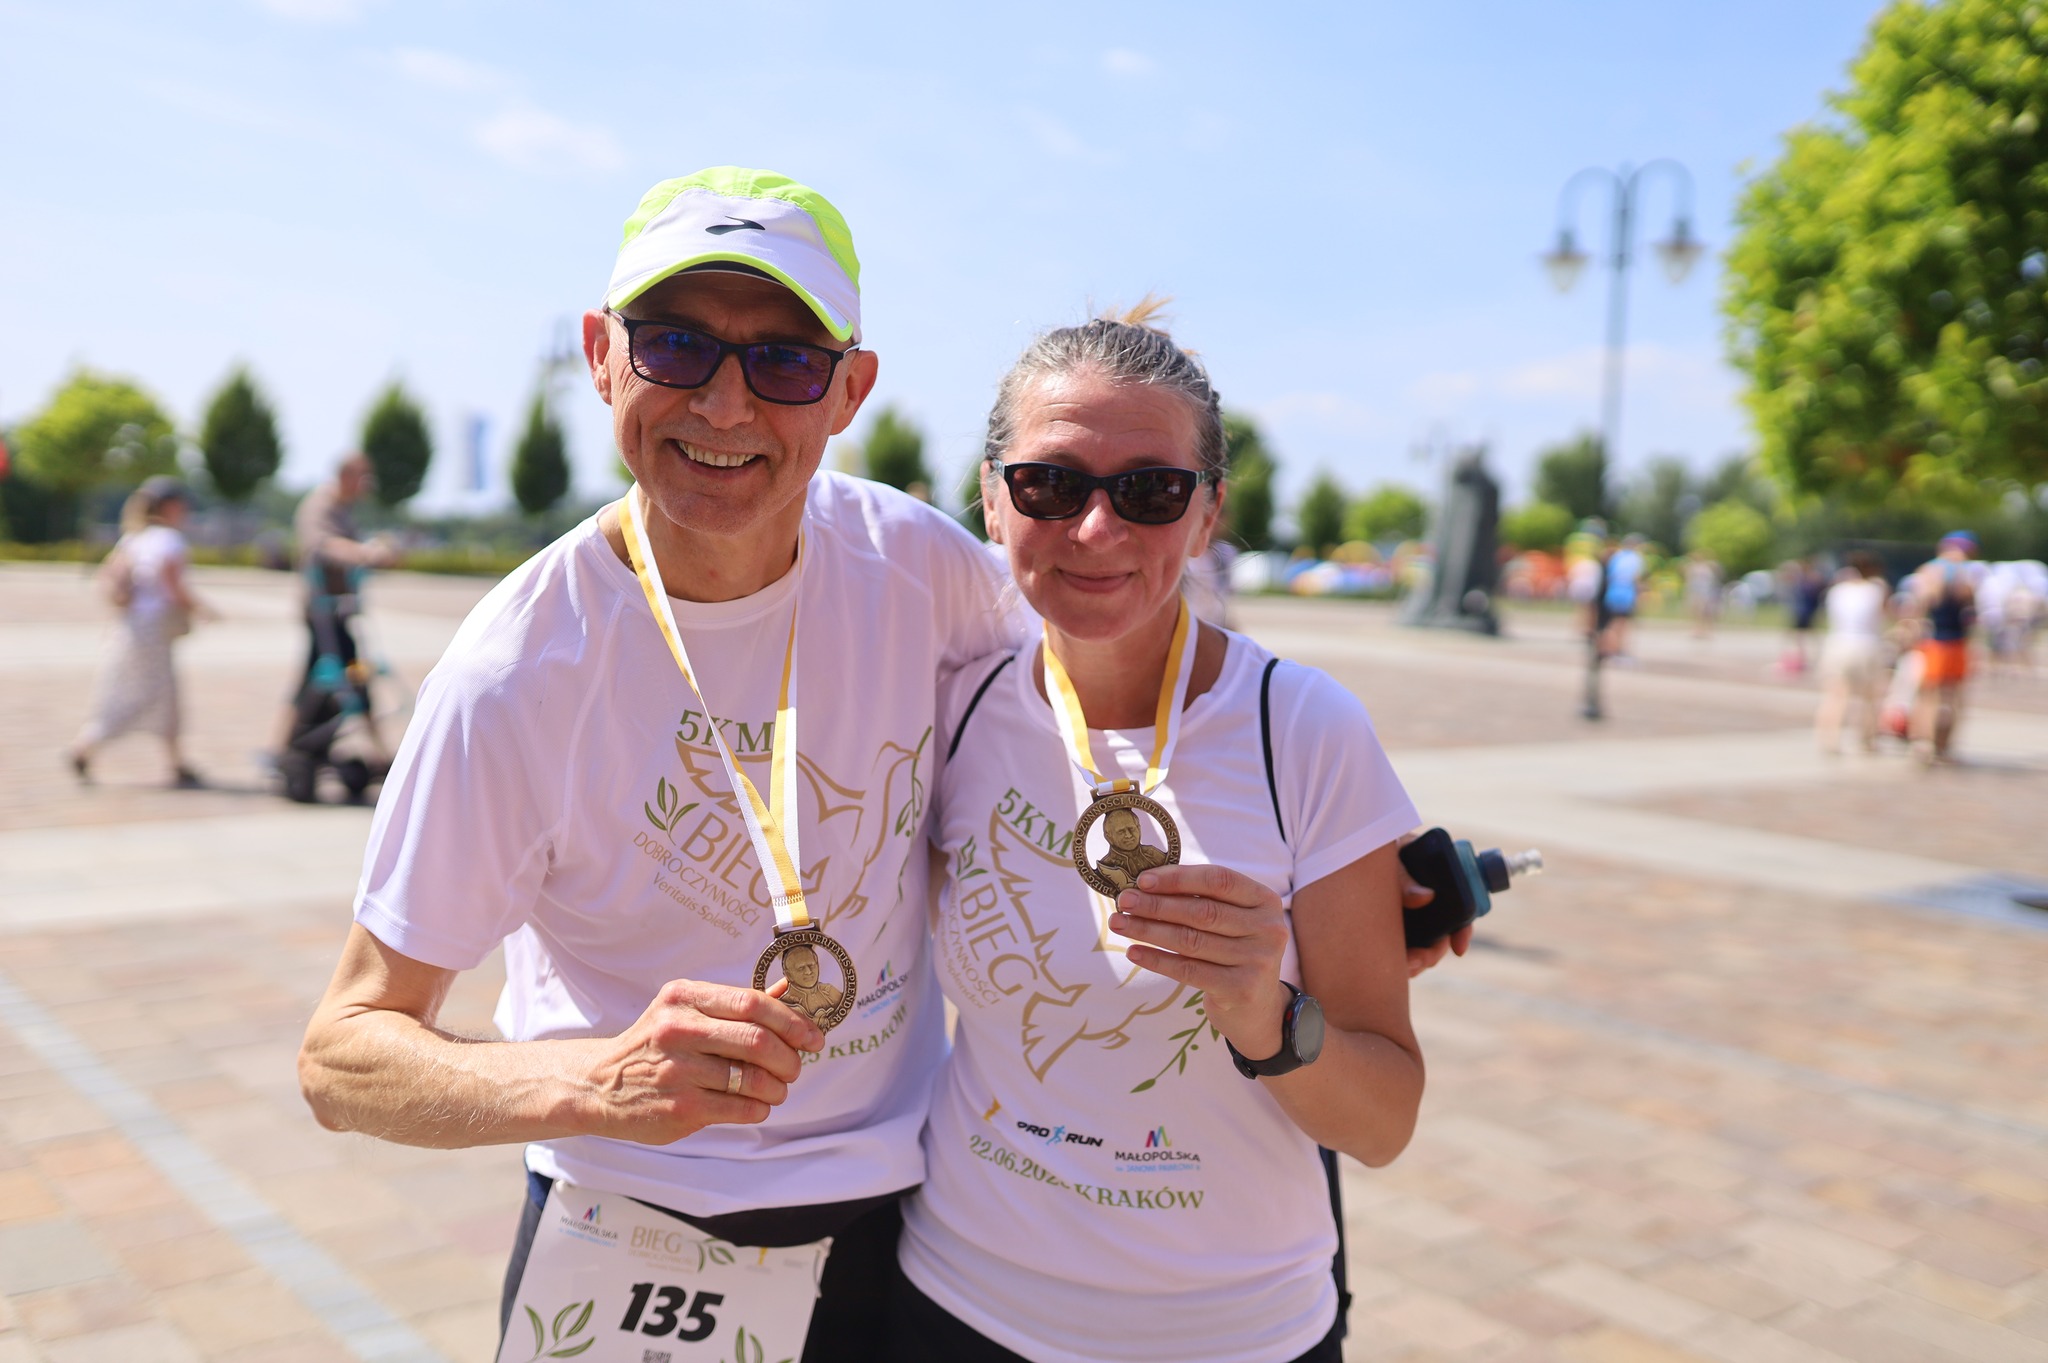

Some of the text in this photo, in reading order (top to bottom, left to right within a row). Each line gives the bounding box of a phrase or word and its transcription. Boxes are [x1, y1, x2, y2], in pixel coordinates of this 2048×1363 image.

[676, 709, 775, 753] 5KM
[997, 787, 1074, 858] 5KM
[1086, 876, 1110, 894] BIEG
[1128, 797, 1172, 830] VERITATIS
[1168, 831, 1179, 865] SPLEN
[653, 872, 698, 911] Veritatis
[960, 882, 1038, 996] BIEG
[755, 933, 806, 989] ROCZYNNOŚCI
[809, 933, 852, 967] VERITATIS
[834, 968, 856, 1021] SPLENDOR
[1065, 1132, 1104, 1147] RUN
[1114, 1150, 1201, 1162] MAŁOPOLSKA
[1074, 1183, 1204, 1210] KRAKÓW
[629, 1225, 683, 1254] BIEG
[619, 1282, 725, 1343] 135
